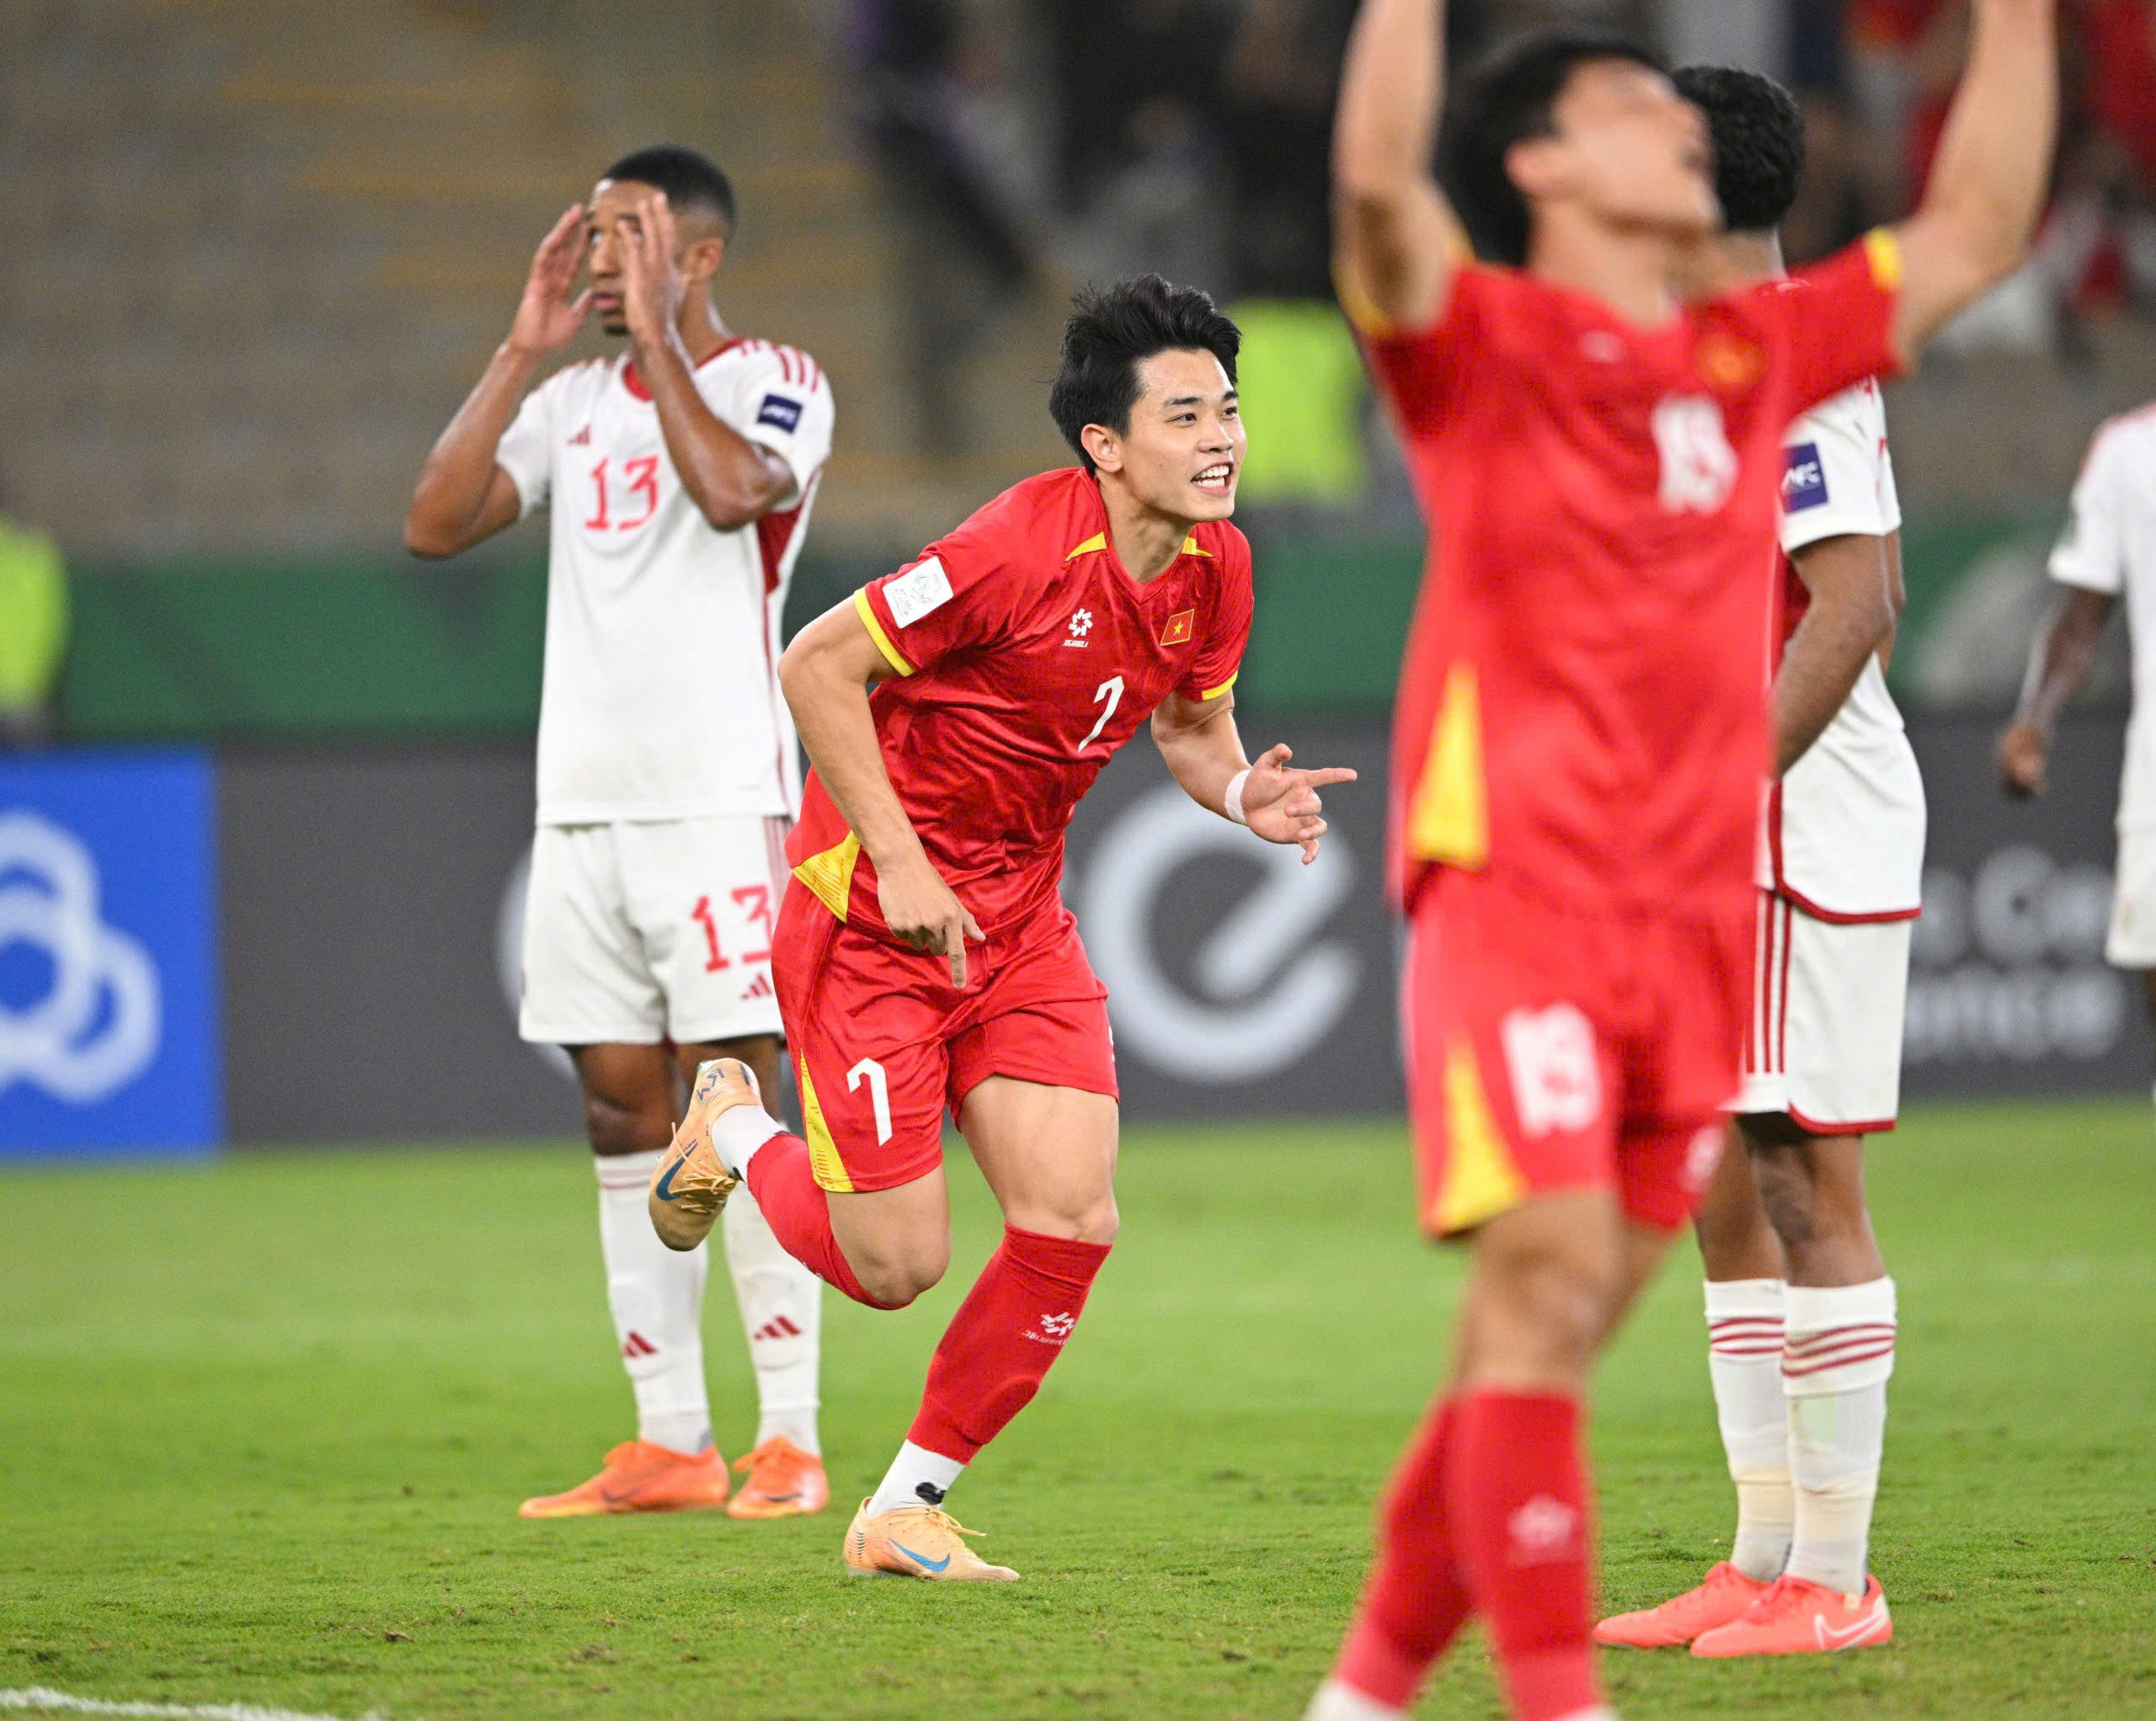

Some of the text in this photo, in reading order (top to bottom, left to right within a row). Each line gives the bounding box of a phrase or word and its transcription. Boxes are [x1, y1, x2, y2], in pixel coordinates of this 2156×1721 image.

[584, 456, 660, 532] 13
[1077, 674, 1125, 754] 7
[691, 883, 773, 974] 13
[846, 1057, 893, 1146] 7
